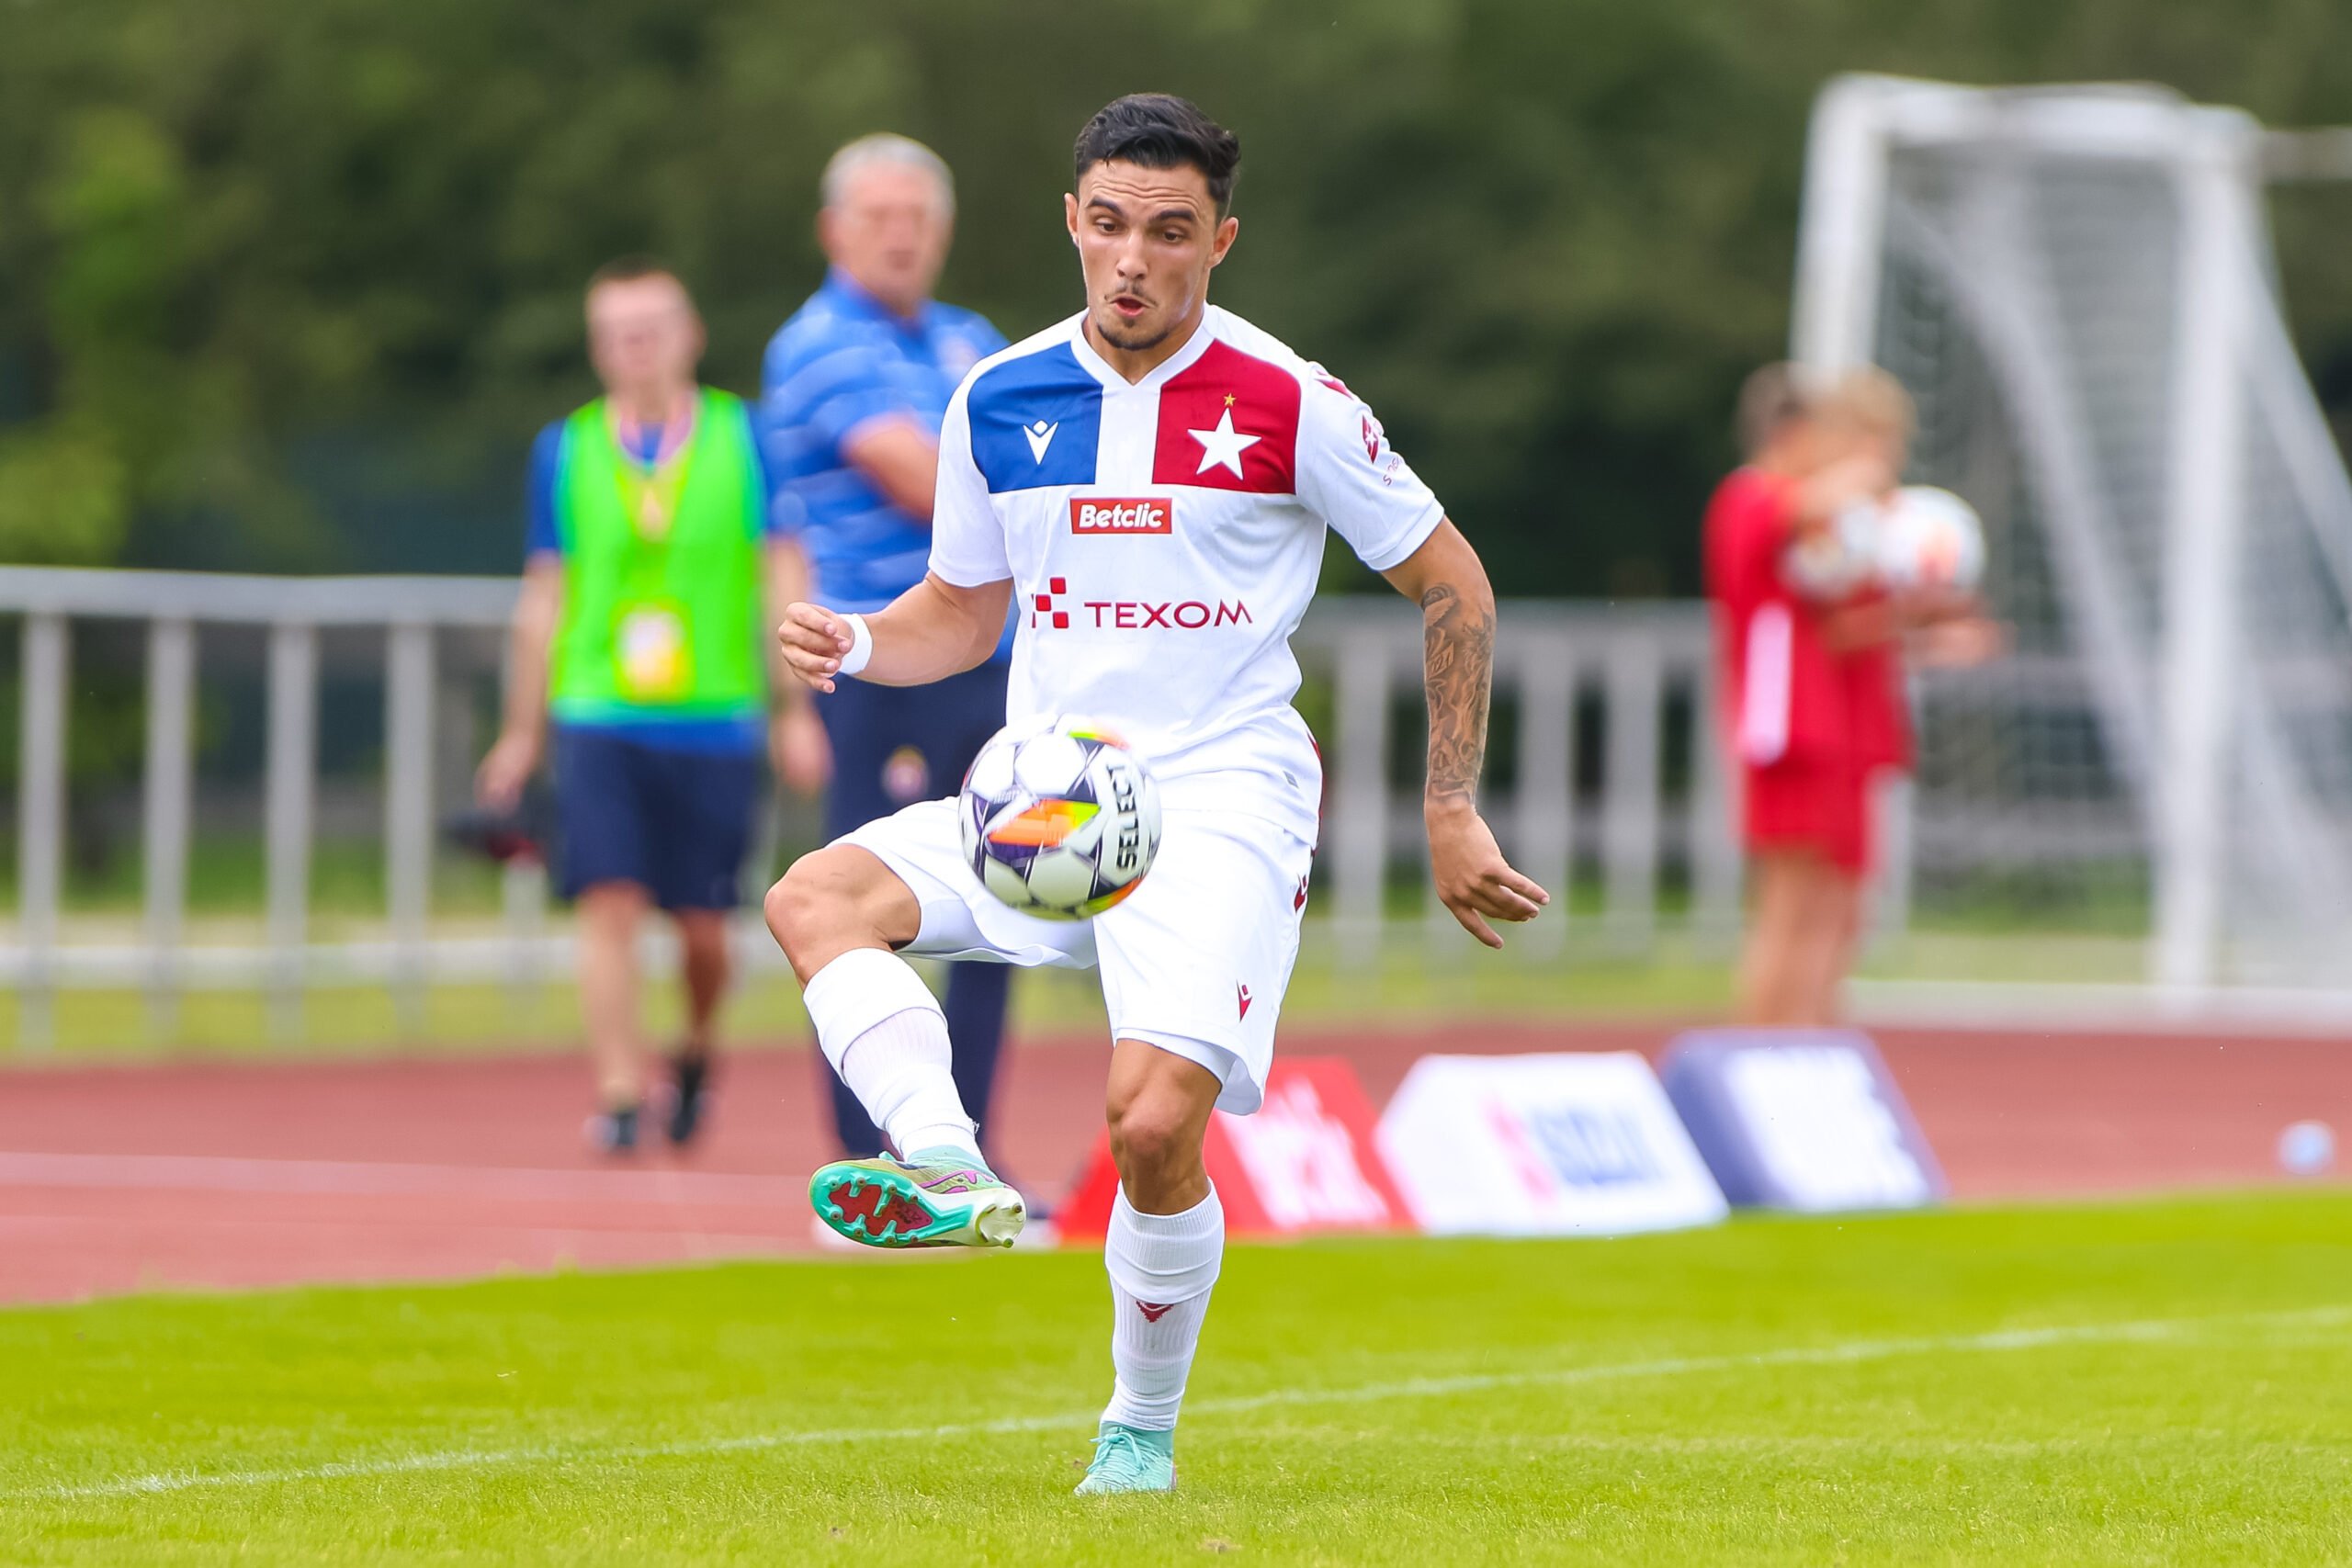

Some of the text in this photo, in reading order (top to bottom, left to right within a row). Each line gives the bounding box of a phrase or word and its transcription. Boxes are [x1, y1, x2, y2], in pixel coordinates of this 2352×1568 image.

[1079, 502, 1163, 528] Betclic
[1084, 599, 1253, 628] TEXOM
[1106, 764, 1139, 869] SELECT
